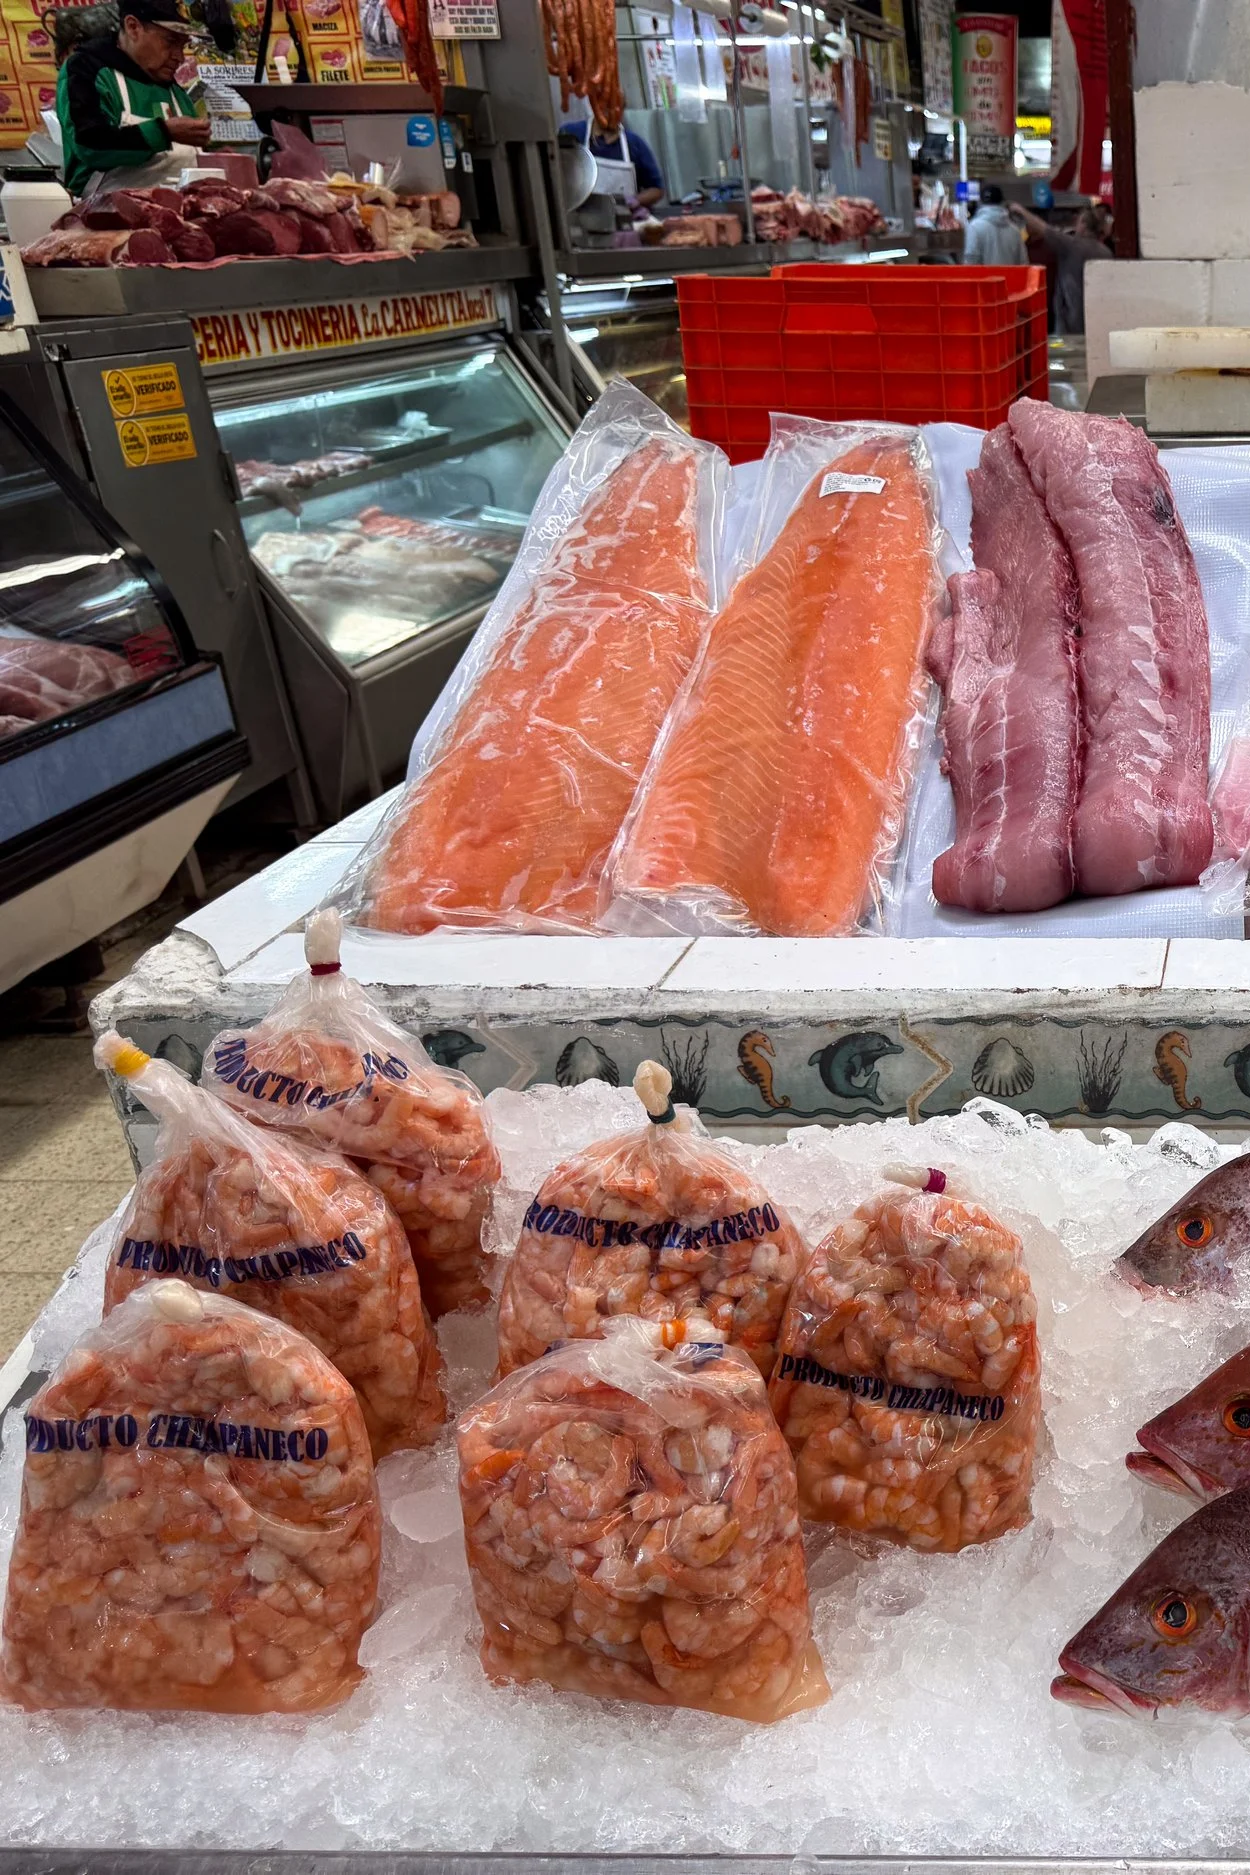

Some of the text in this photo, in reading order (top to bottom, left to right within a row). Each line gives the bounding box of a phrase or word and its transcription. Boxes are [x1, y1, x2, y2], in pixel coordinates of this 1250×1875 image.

[312, 22, 338, 31] MACIZA
[321, 69, 350, 83] FILETE
[246, 312, 262, 357] Y
[260, 303, 362, 353] TOCINERIA
[380, 290, 467, 334] CARMELITA
[135, 380, 177, 395] VERIFICADO
[148, 431, 189, 446] VERIFICADO
[887, 1384, 1005, 1422] CHIAPANECO
